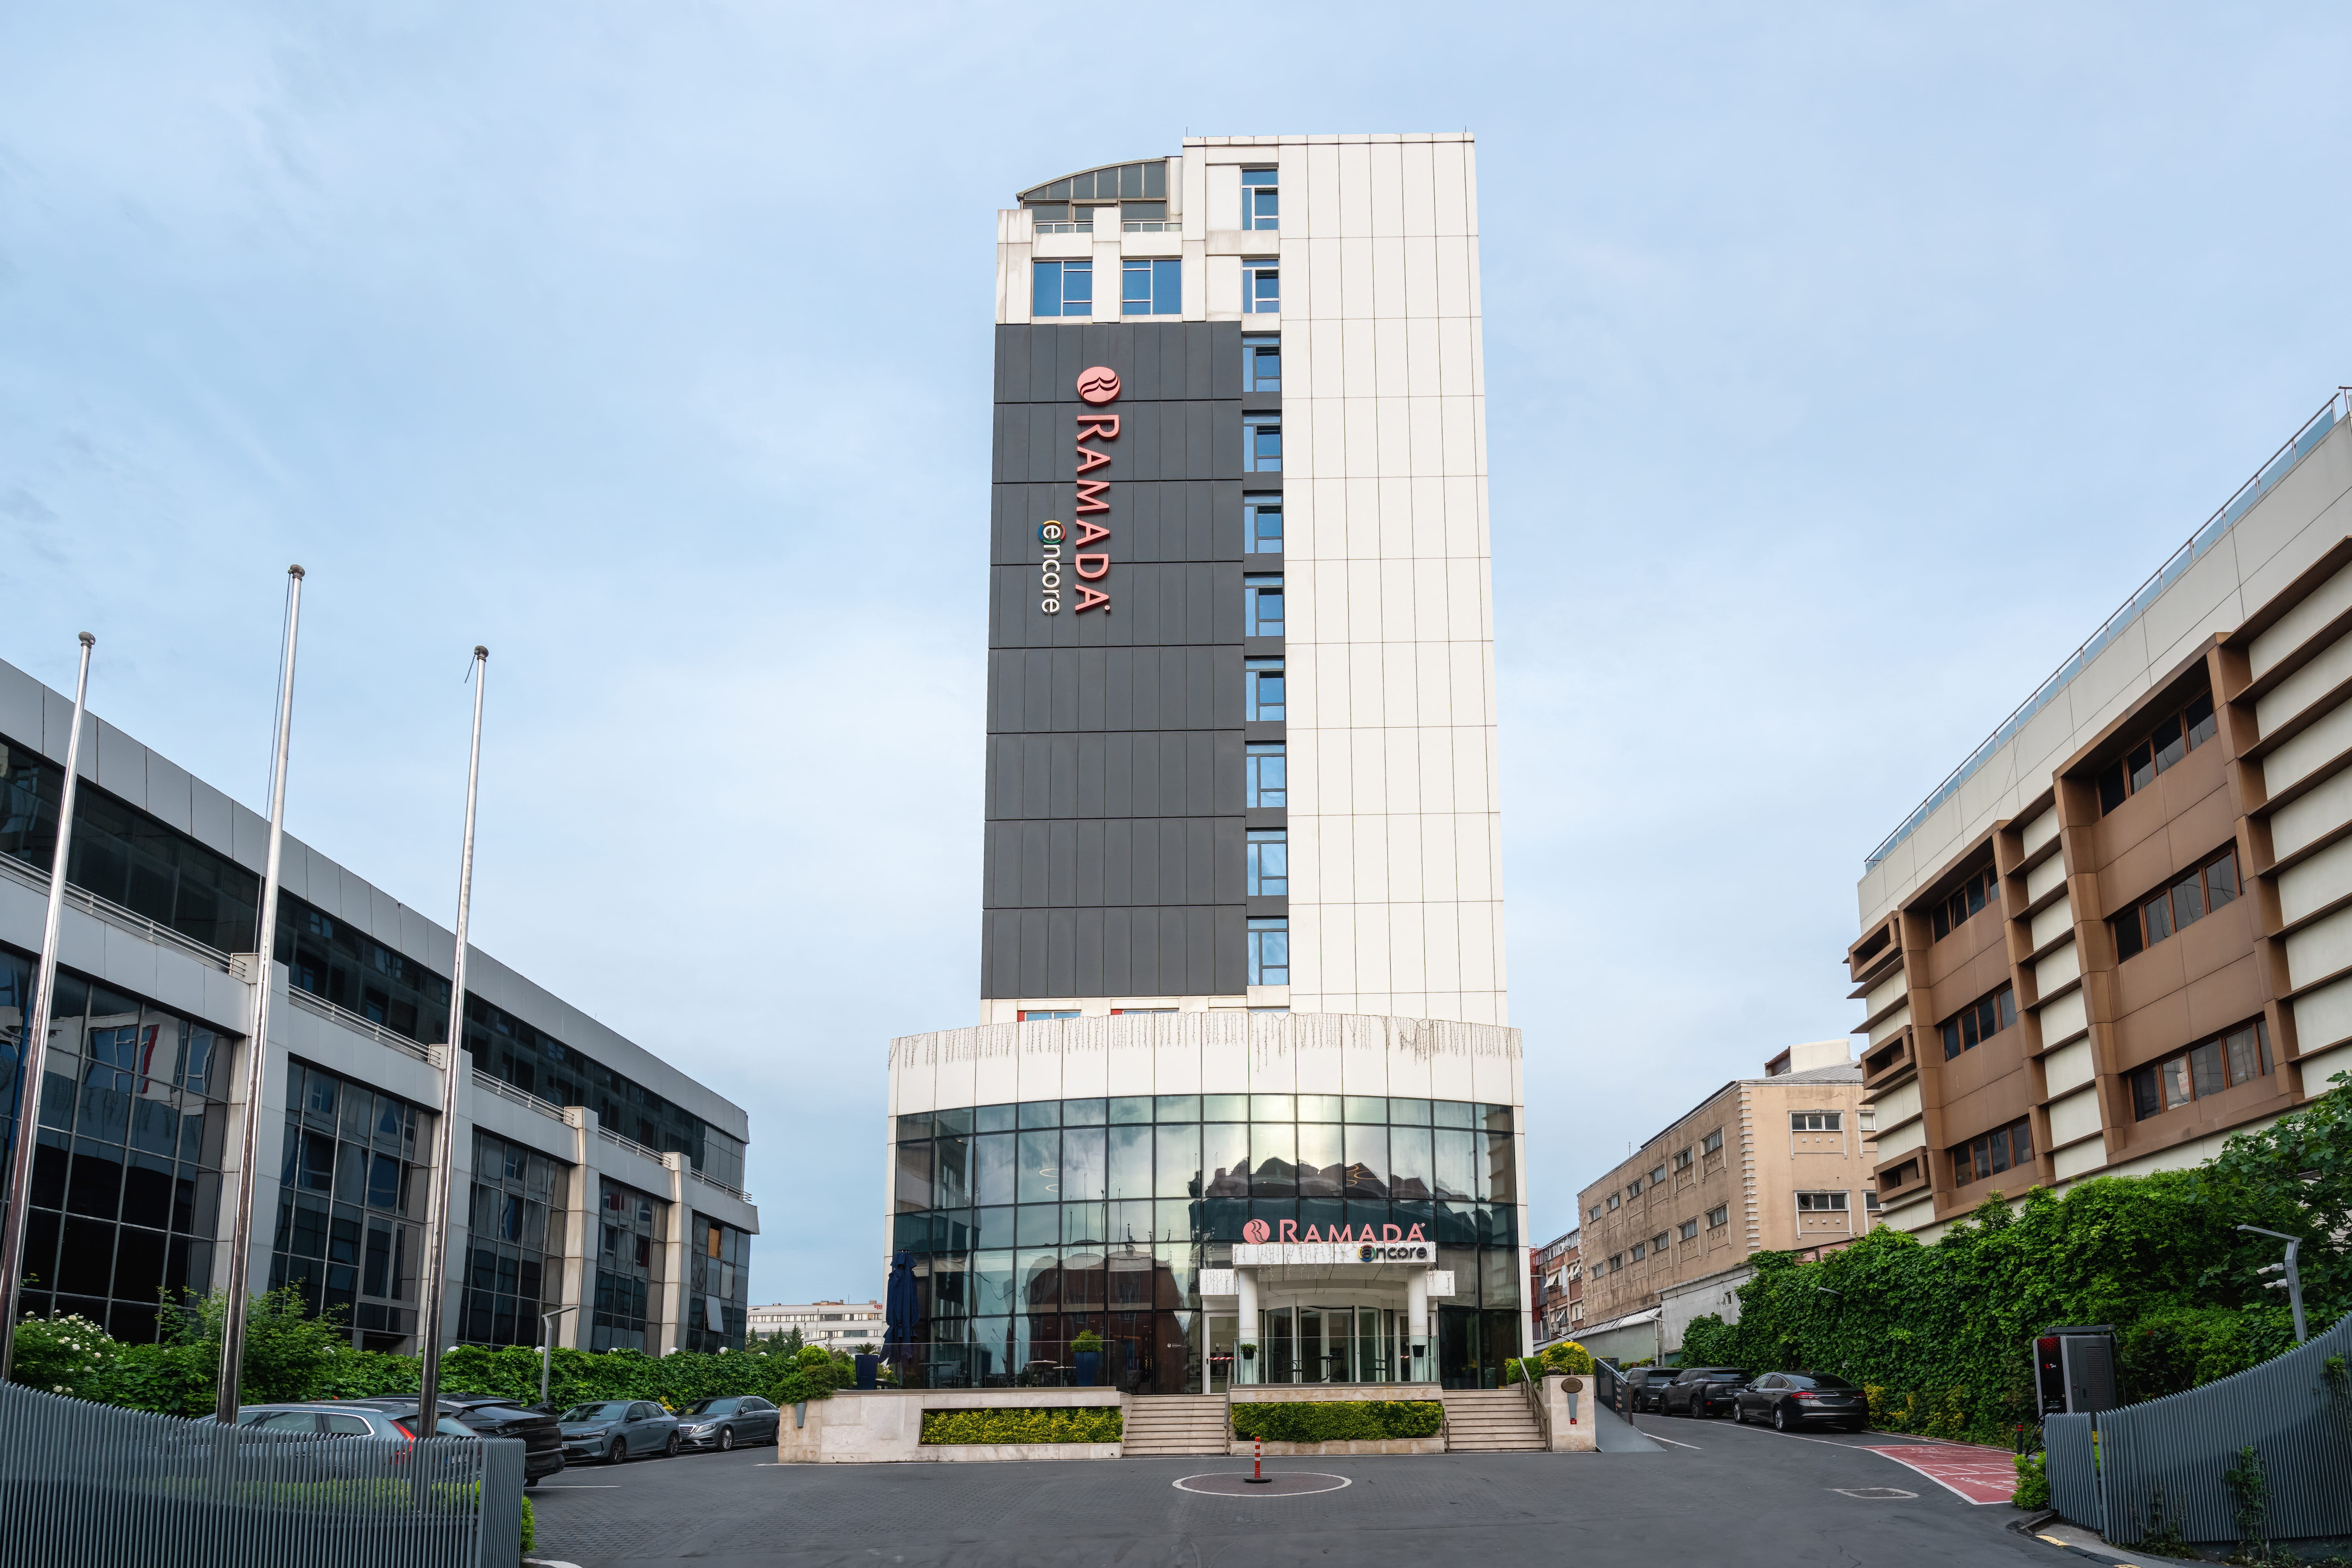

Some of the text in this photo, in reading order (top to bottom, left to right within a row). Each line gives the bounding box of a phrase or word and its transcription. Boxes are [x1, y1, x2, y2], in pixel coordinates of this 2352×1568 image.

[1075, 414, 1119, 614] RAMADA
[1041, 524, 1061, 615] encore
[1280, 1219, 1424, 1244] RAMADA
[1361, 1245, 1427, 1260] encore
